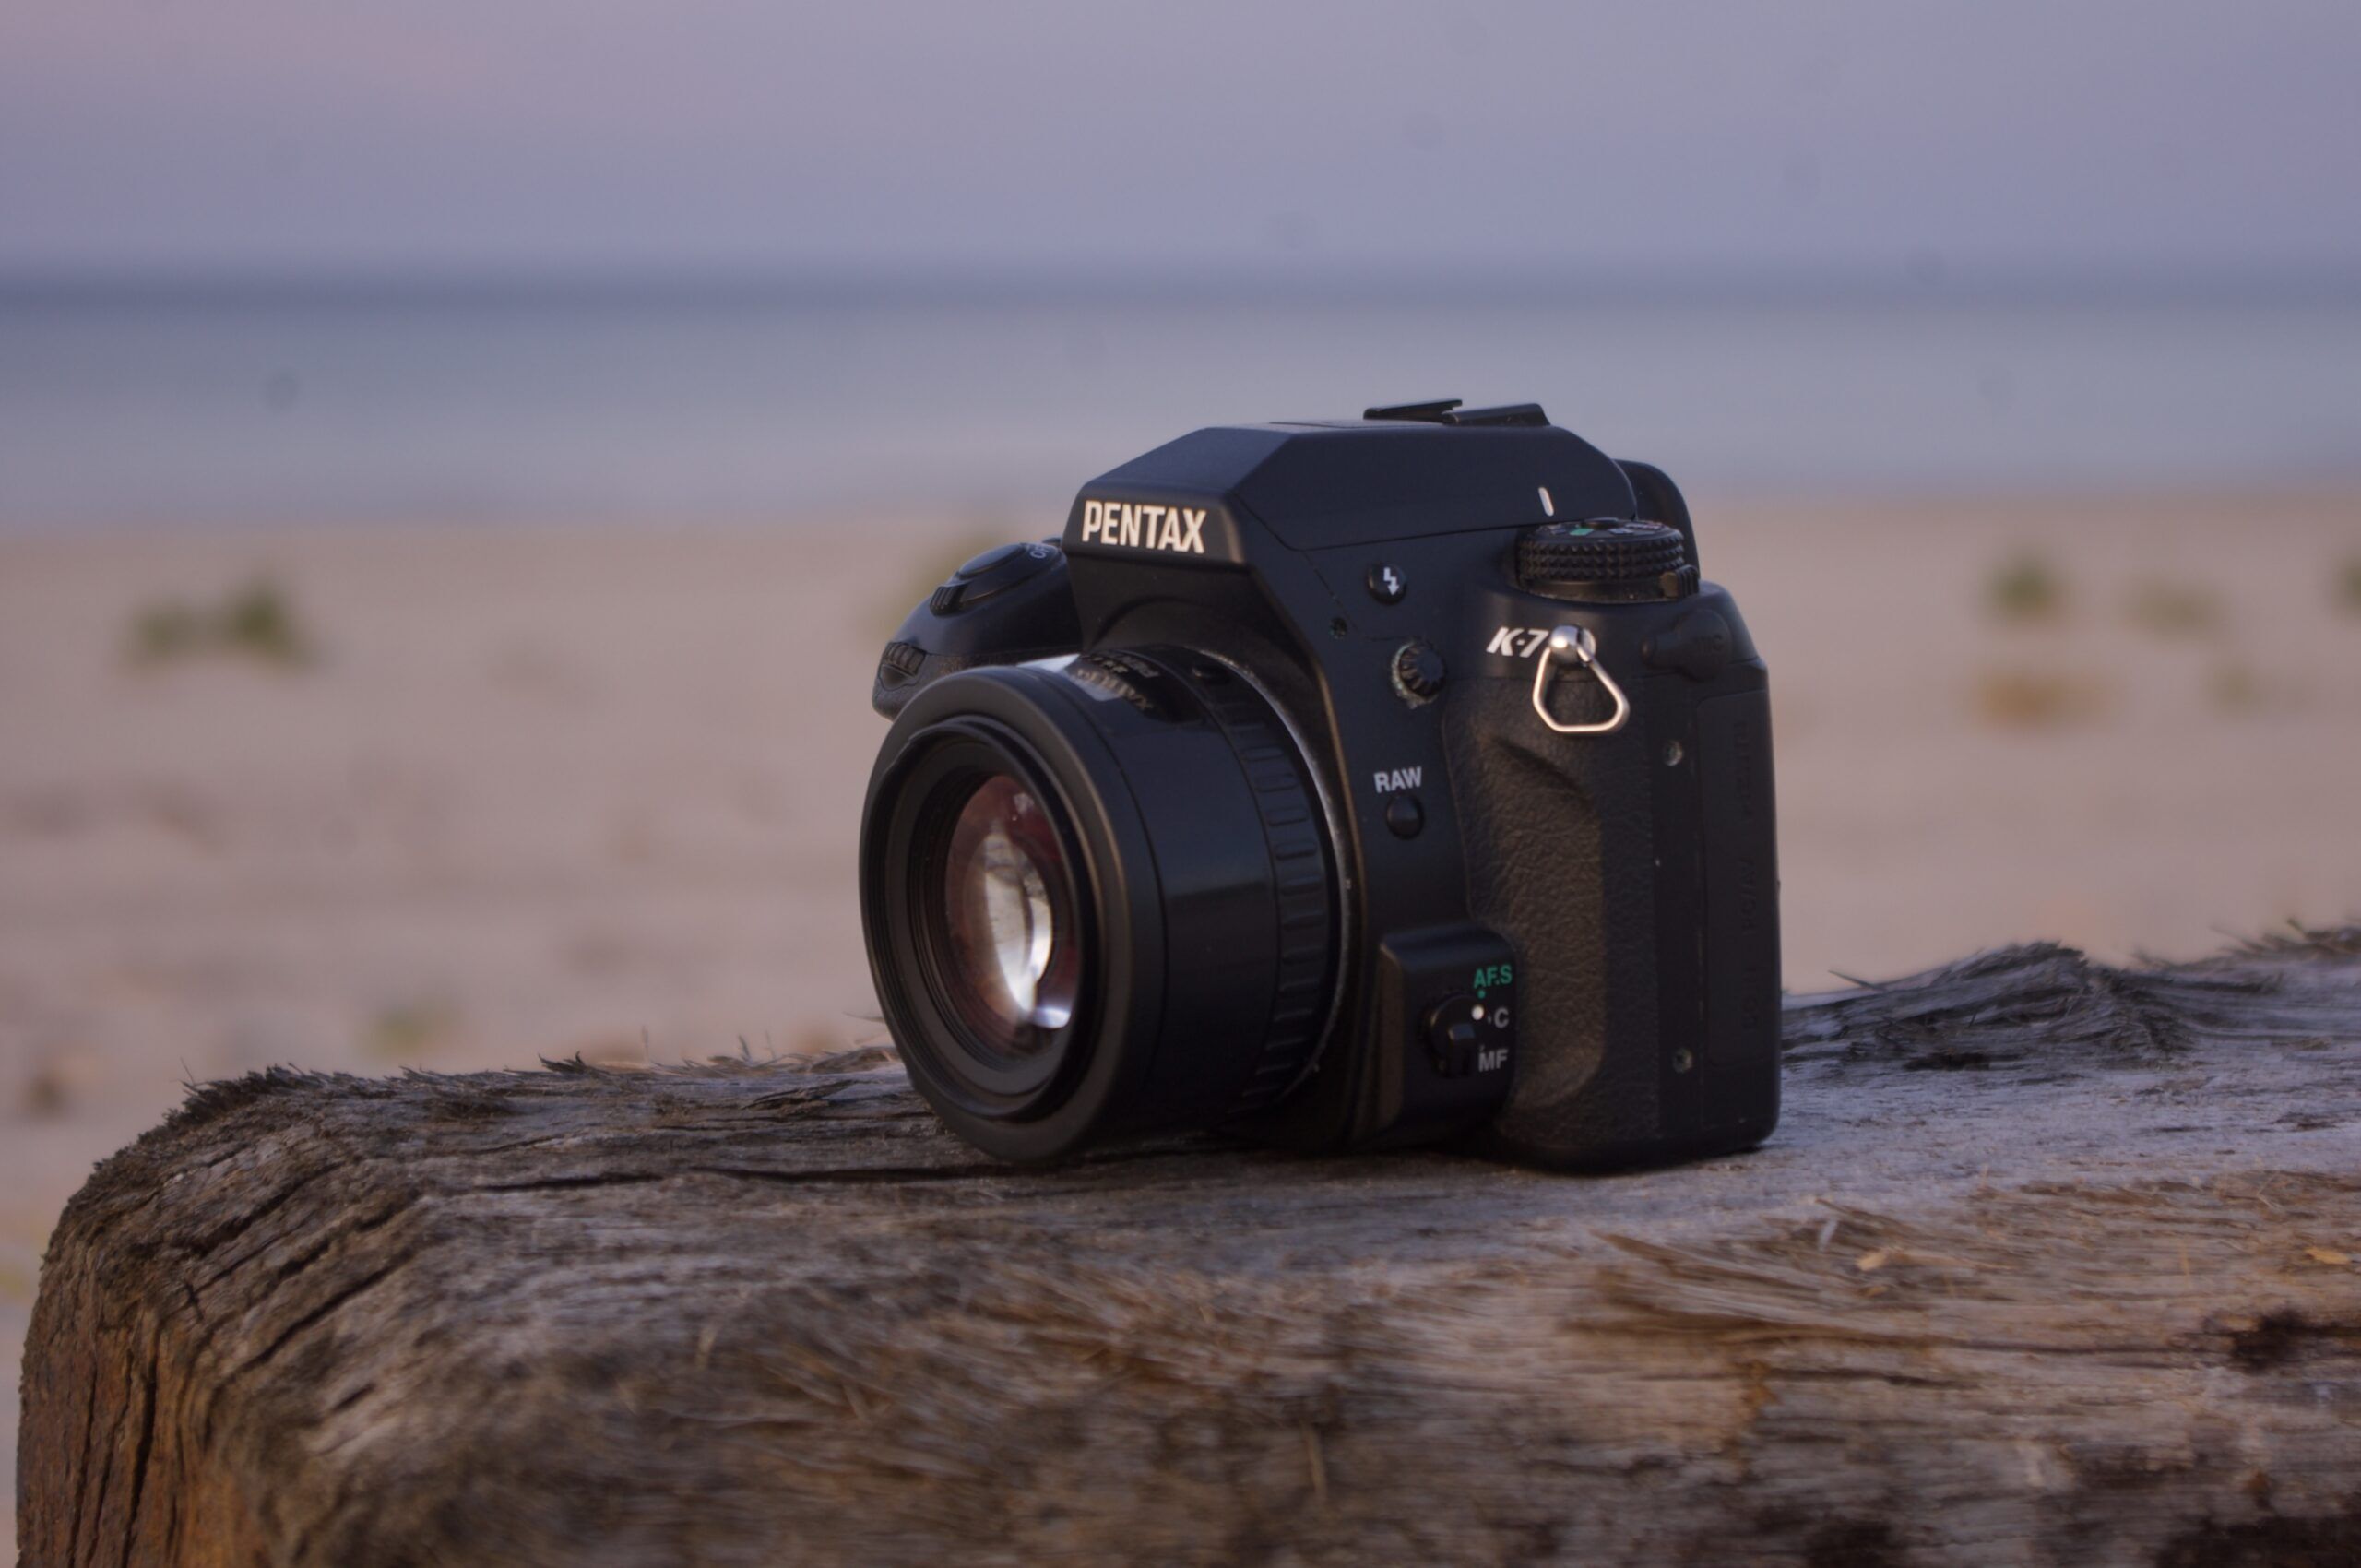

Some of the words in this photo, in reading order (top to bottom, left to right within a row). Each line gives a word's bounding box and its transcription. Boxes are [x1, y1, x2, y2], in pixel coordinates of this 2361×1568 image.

[1081, 499, 1207, 554] PENTAX
[1373, 766, 1422, 794] RAW
[1494, 1006, 1509, 1028] C
[1478, 1048, 1509, 1072] MF
